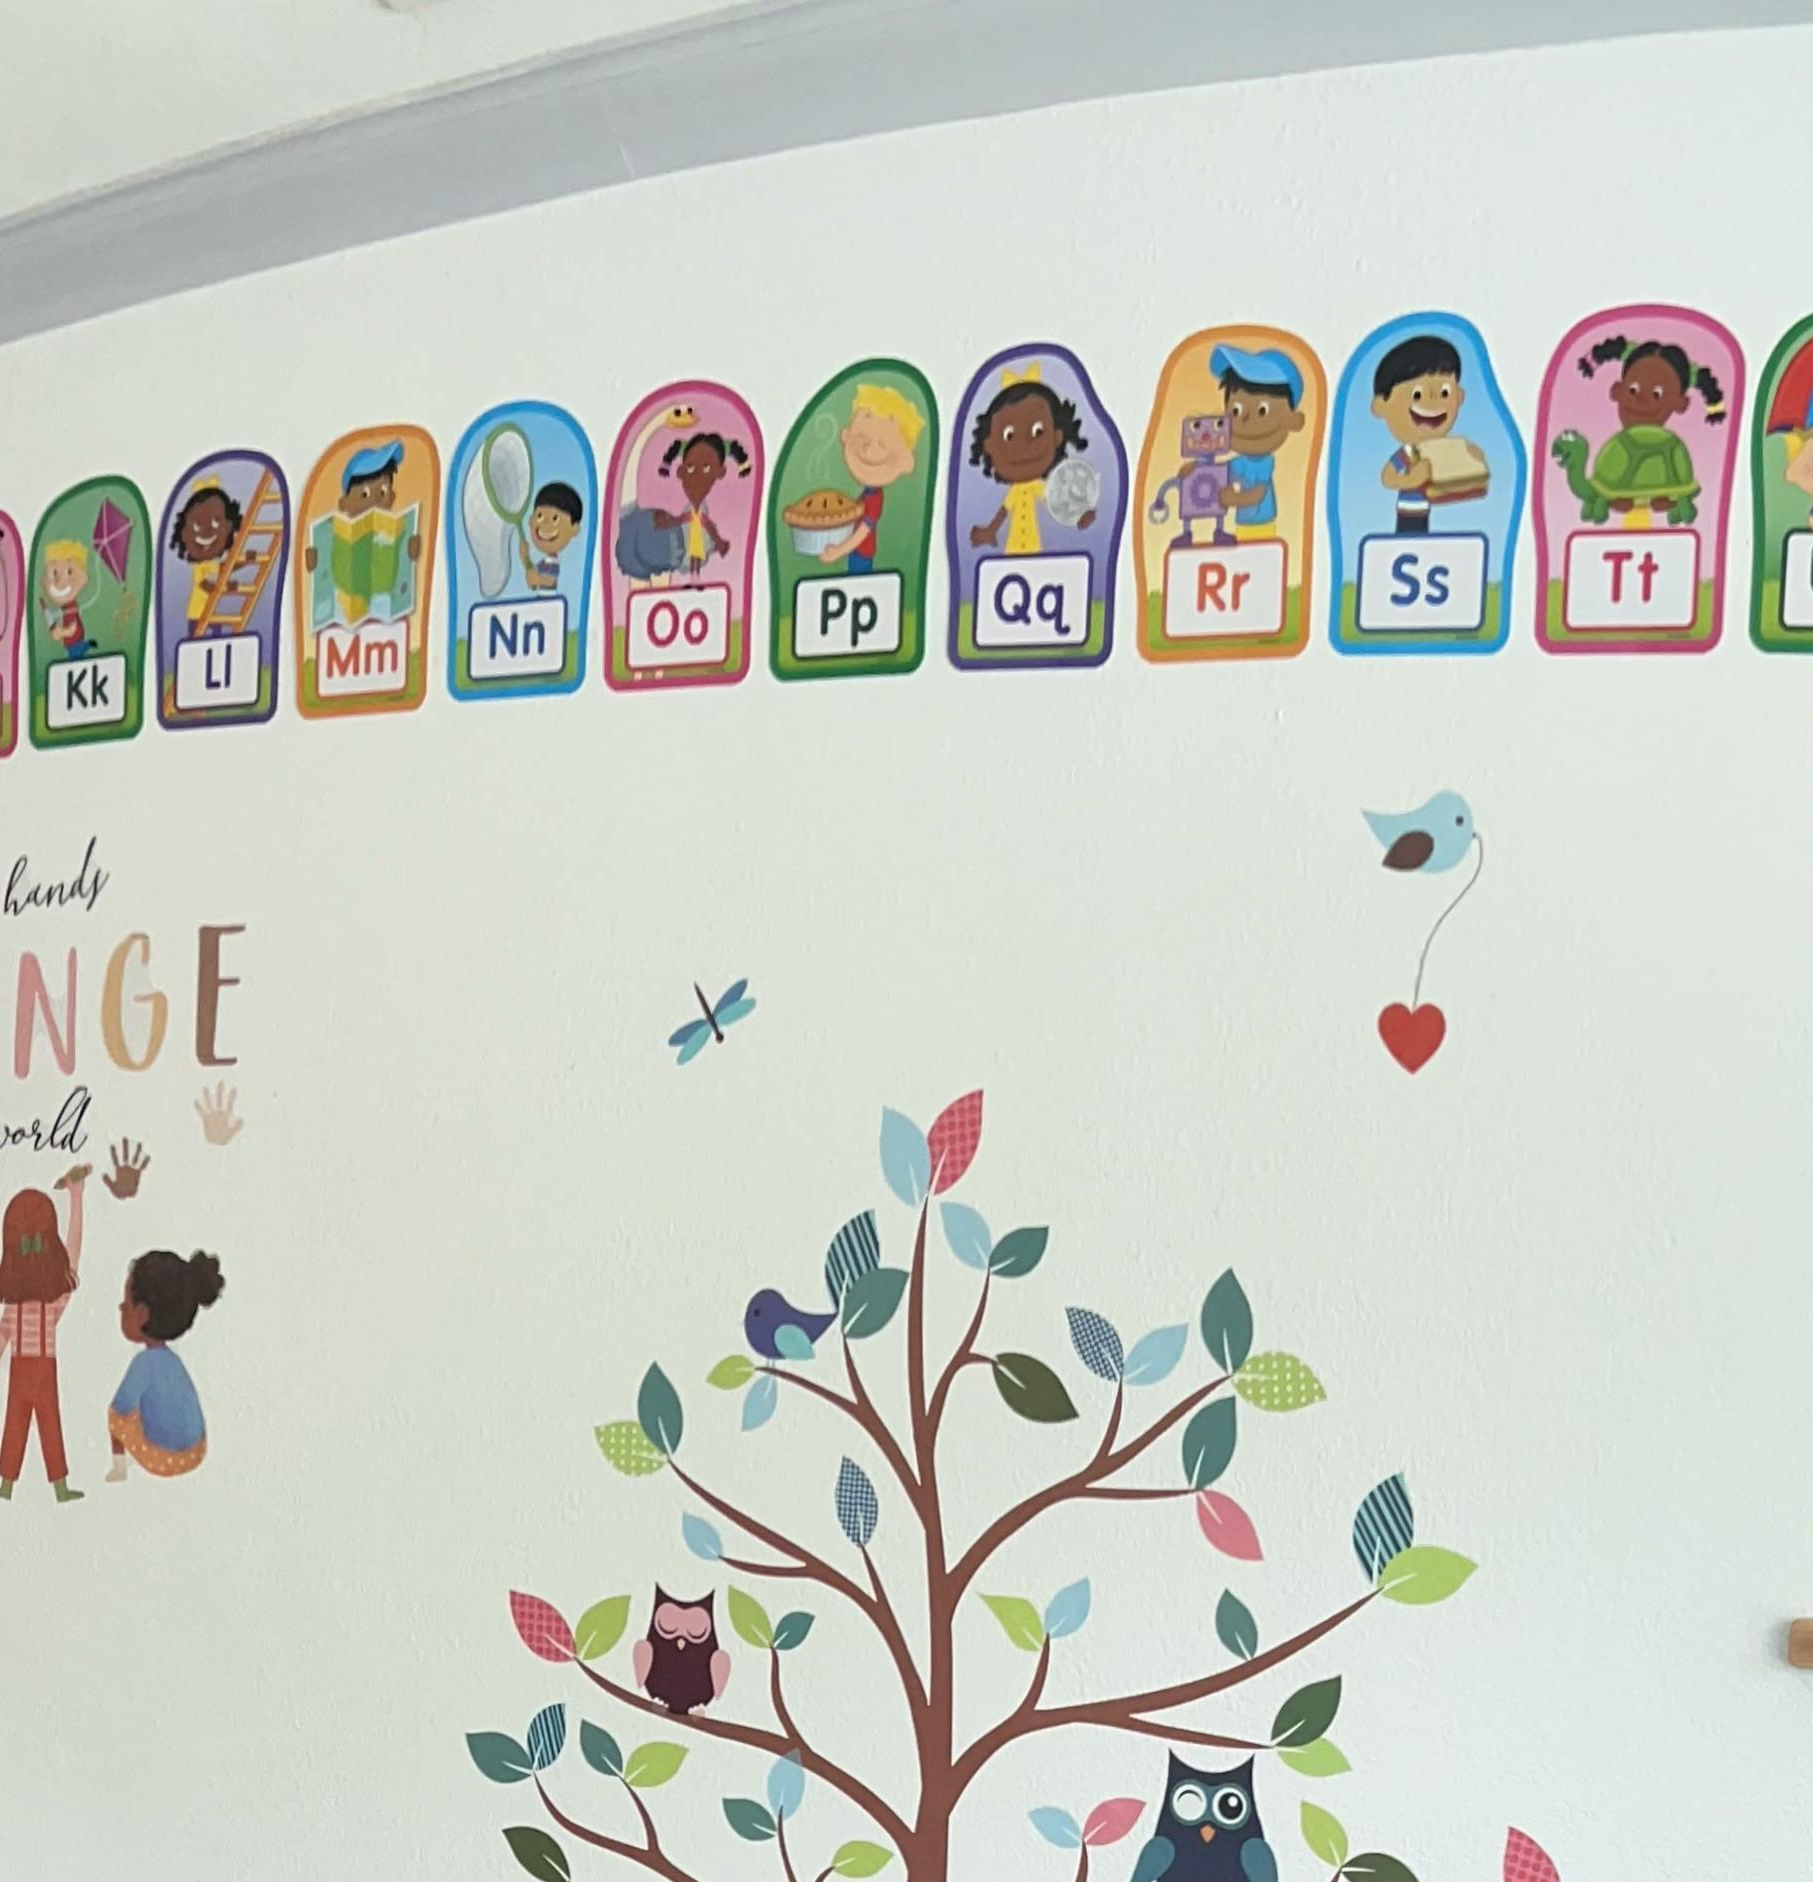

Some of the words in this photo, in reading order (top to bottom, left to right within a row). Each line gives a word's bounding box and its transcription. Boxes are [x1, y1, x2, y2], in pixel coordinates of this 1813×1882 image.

[1196, 561, 1250, 611] Rr
[1390, 552, 1451, 605] Ss
[1603, 549, 1658, 603] Tt
[646, 605, 710, 647] Oo
[818, 587, 880, 644] Pp
[991, 573, 1068, 632] Qq
[325, 634, 399, 678] Mm
[486, 614, 546, 657] Nn
[63, 667, 110, 708] Kk
[203, 657, 233, 691] Ll
[3, 835, 110, 916] hands
